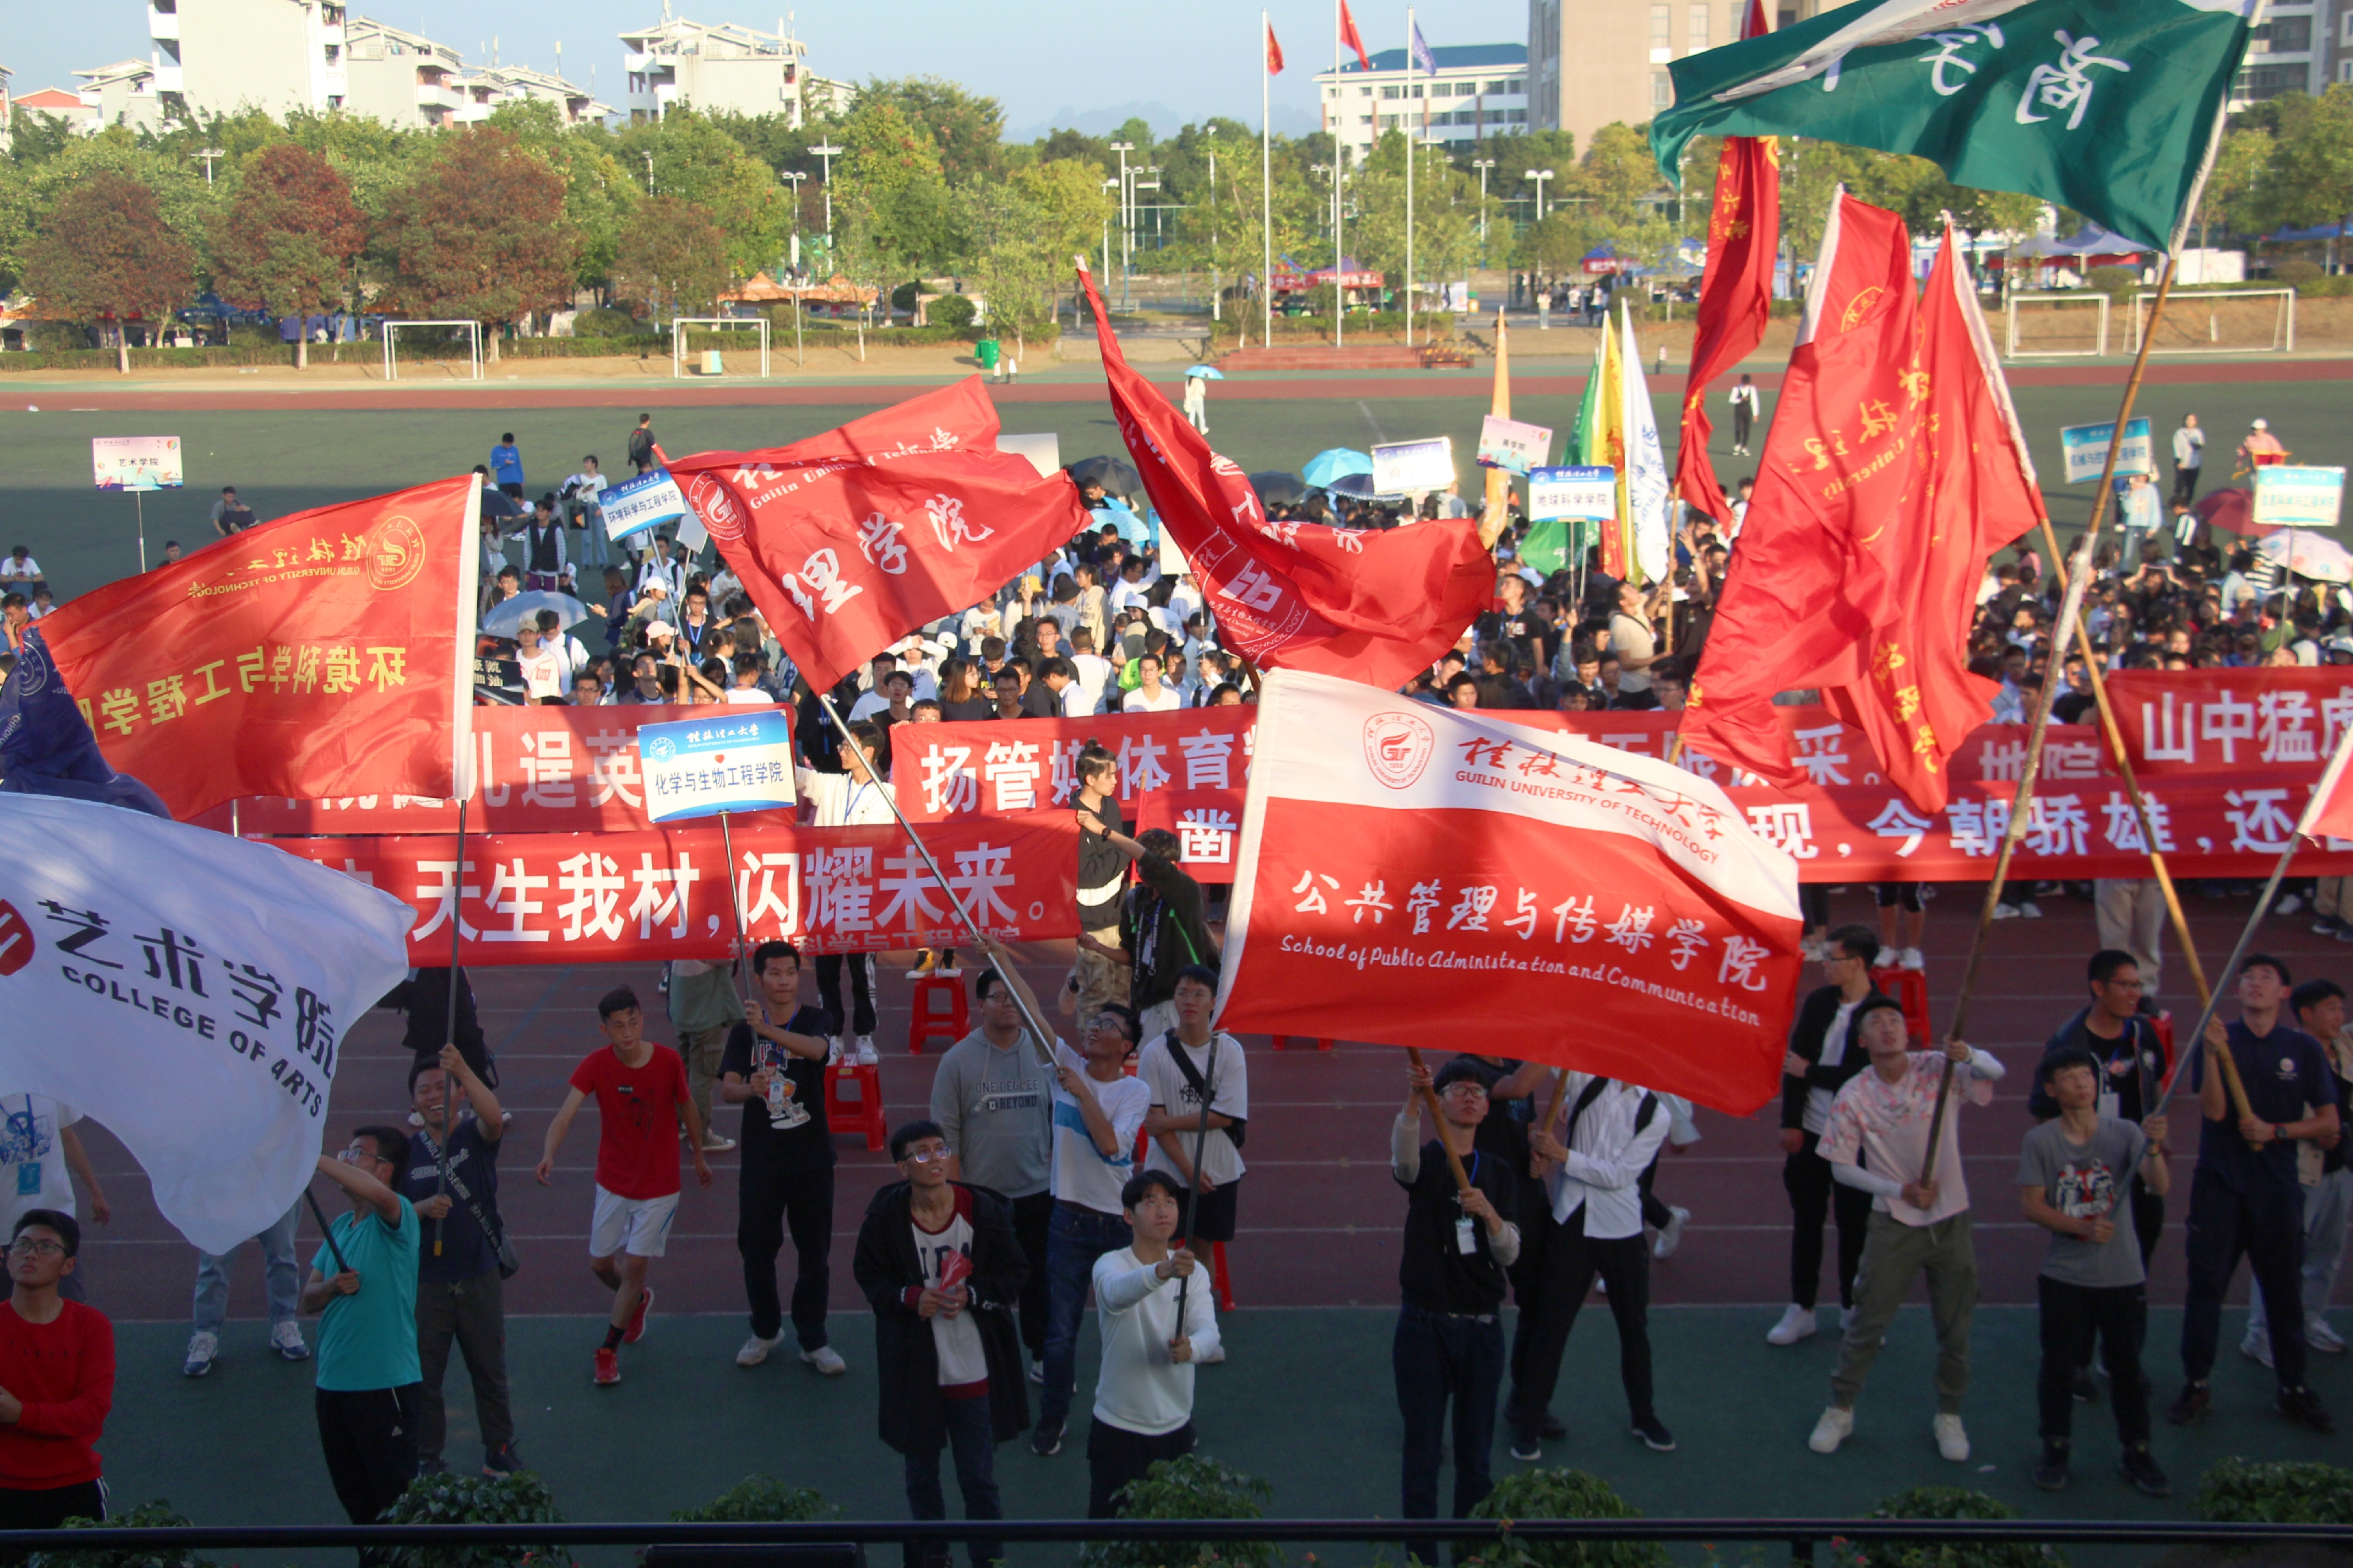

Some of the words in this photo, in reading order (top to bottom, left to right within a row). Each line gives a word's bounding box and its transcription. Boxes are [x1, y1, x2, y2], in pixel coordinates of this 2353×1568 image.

[118, 458, 159, 466] 艺术学院
[608, 490, 678, 524] 环境科学与工程学院
[749, 482, 799, 511] Guilin
[1537, 493, 1607, 507] 地球科学学院
[782, 493, 994, 622] 理学院
[686, 723, 759, 743] 桂林理工大学
[655, 761, 784, 795] 化学与生物工程学院
[1455, 770, 1507, 789] GUILIN
[1510, 782, 1598, 805] UNIVERSITY
[1600, 798, 1621, 810] OF
[1624, 805, 1719, 865] TECHNOLOGY
[312, 841, 1044, 942] 天生我材，闪耀未来。
[1291, 870, 1772, 992] 公共管理与传媒学院
[37, 899, 335, 1079] 艺术学院
[1280, 934, 1345, 961] School
[1347, 944, 1369, 971] of
[1370, 947, 1425, 969] Public
[1567, 963, 1604, 983] and
[1607, 967, 1761, 1027] Communication
[61, 965, 215, 1040] COLLEGE
[230, 1031, 267, 1063] OF
[271, 1058, 323, 1118] ARTS
[975, 1082, 997, 1093] ONE
[1000, 1095, 1037, 1110] BEYOND
